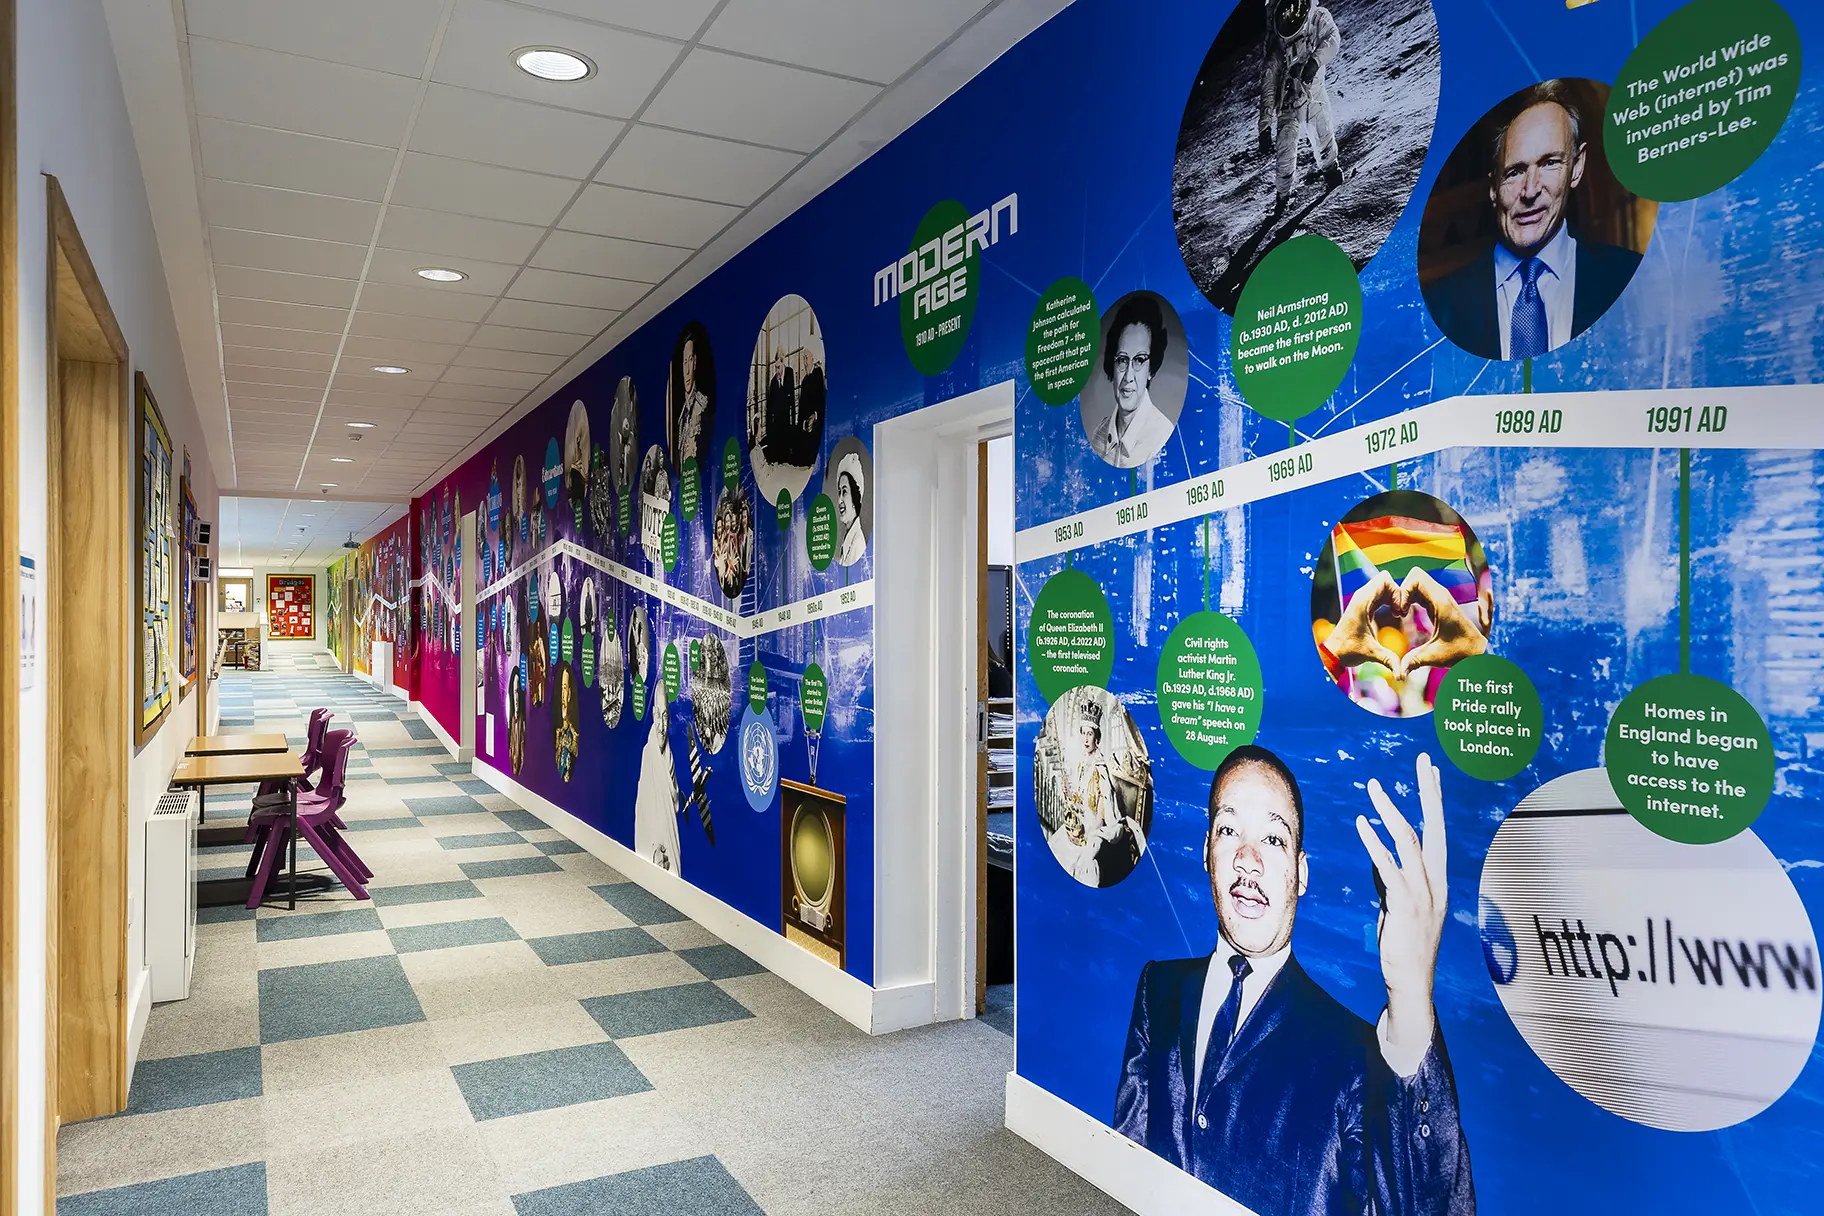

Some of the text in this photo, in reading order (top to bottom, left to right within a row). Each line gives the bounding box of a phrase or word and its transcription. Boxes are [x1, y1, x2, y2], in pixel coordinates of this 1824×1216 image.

[1627, 33, 1771, 98] The World Wide
[1613, 53, 1788, 125] Web (internet) was
[1626, 83, 1771, 144] invented by Tim
[1637, 115, 1757, 163] Berners-Lee.
[874, 193, 1017, 307] MODERN
[914, 266, 967, 320] AGE
[1046, 295, 1076, 311] Katherine
[1033, 300, 1091, 332] Johnson calculated
[1258, 292, 1328, 321] Neil Armstrong
[928, 328, 934, 342] AD
[938, 315, 961, 337] PRESENT
[1043, 320, 1079, 338] the path for
[1239, 302, 1348, 345] (b.1930 AD, d. 2012 AD)
[1038, 340, 1064, 353] Freedom
[1065, 336, 1069, 344] 7
[1075, 332, 1085, 340] the
[1238, 322, 1351, 360] became the first person
[1032, 343, 1091, 370] spacecraft that put
[1244, 342, 1344, 374] to walk on the Moon.
[1034, 359, 1088, 380] the first American
[1048, 379, 1075, 390] in space.
[1495, 410, 1562, 434] 1989 AD
[1646, 406, 1727, 433] 1991 AD
[1365, 421, 1418, 454] 1972 AD
[1268, 453, 1313, 482] 1969 AD
[1186, 480, 1224, 506] 1963 AD
[1116, 502, 1148, 526] 1961 AD
[1054, 522, 1083, 543] 1953 AD
[1047, 610, 1094, 619] The coronation
[1047, 624, 1066, 632] Queen
[1068, 623, 1097, 632] Elizabeth
[1059, 637, 1070, 646] AD,
[1071, 637, 1092, 646] d.2022
[1093, 637, 1105, 648] AD)
[1185, 638, 1228, 651] Civil rights
[1047, 650, 1057, 658] the
[1058, 650, 1070, 659] first
[1072, 651, 1100, 660] televised
[1178, 653, 1236, 665] activist Martin
[1053, 664, 1088, 673] coronation.
[1179, 668, 1235, 683] Luther King Jr.
[1163, 682, 1254, 700] (b.1929 AD, d.1968 AD)
[1458, 679, 1513, 694] The first
[1172, 700, 1191, 711] gave
[1193, 699, 1204, 711] his
[1215, 702, 1236, 713] have
[1238, 705, 1244, 714] a
[1452, 699, 1521, 719] Pride rally
[1645, 703, 1727, 722] Homes in
[1202, 718, 1232, 729] speech
[1234, 721, 1245, 730] on
[1444, 719, 1530, 737] took place in
[1186, 730, 1228, 745] 28 August.
[1460, 739, 1514, 756] London.
[1619, 724, 1758, 751] England began
[1652, 751, 1719, 770] to have
[1627, 774, 1746, 797] access to the
[1647, 795, 1724, 819] internet.
